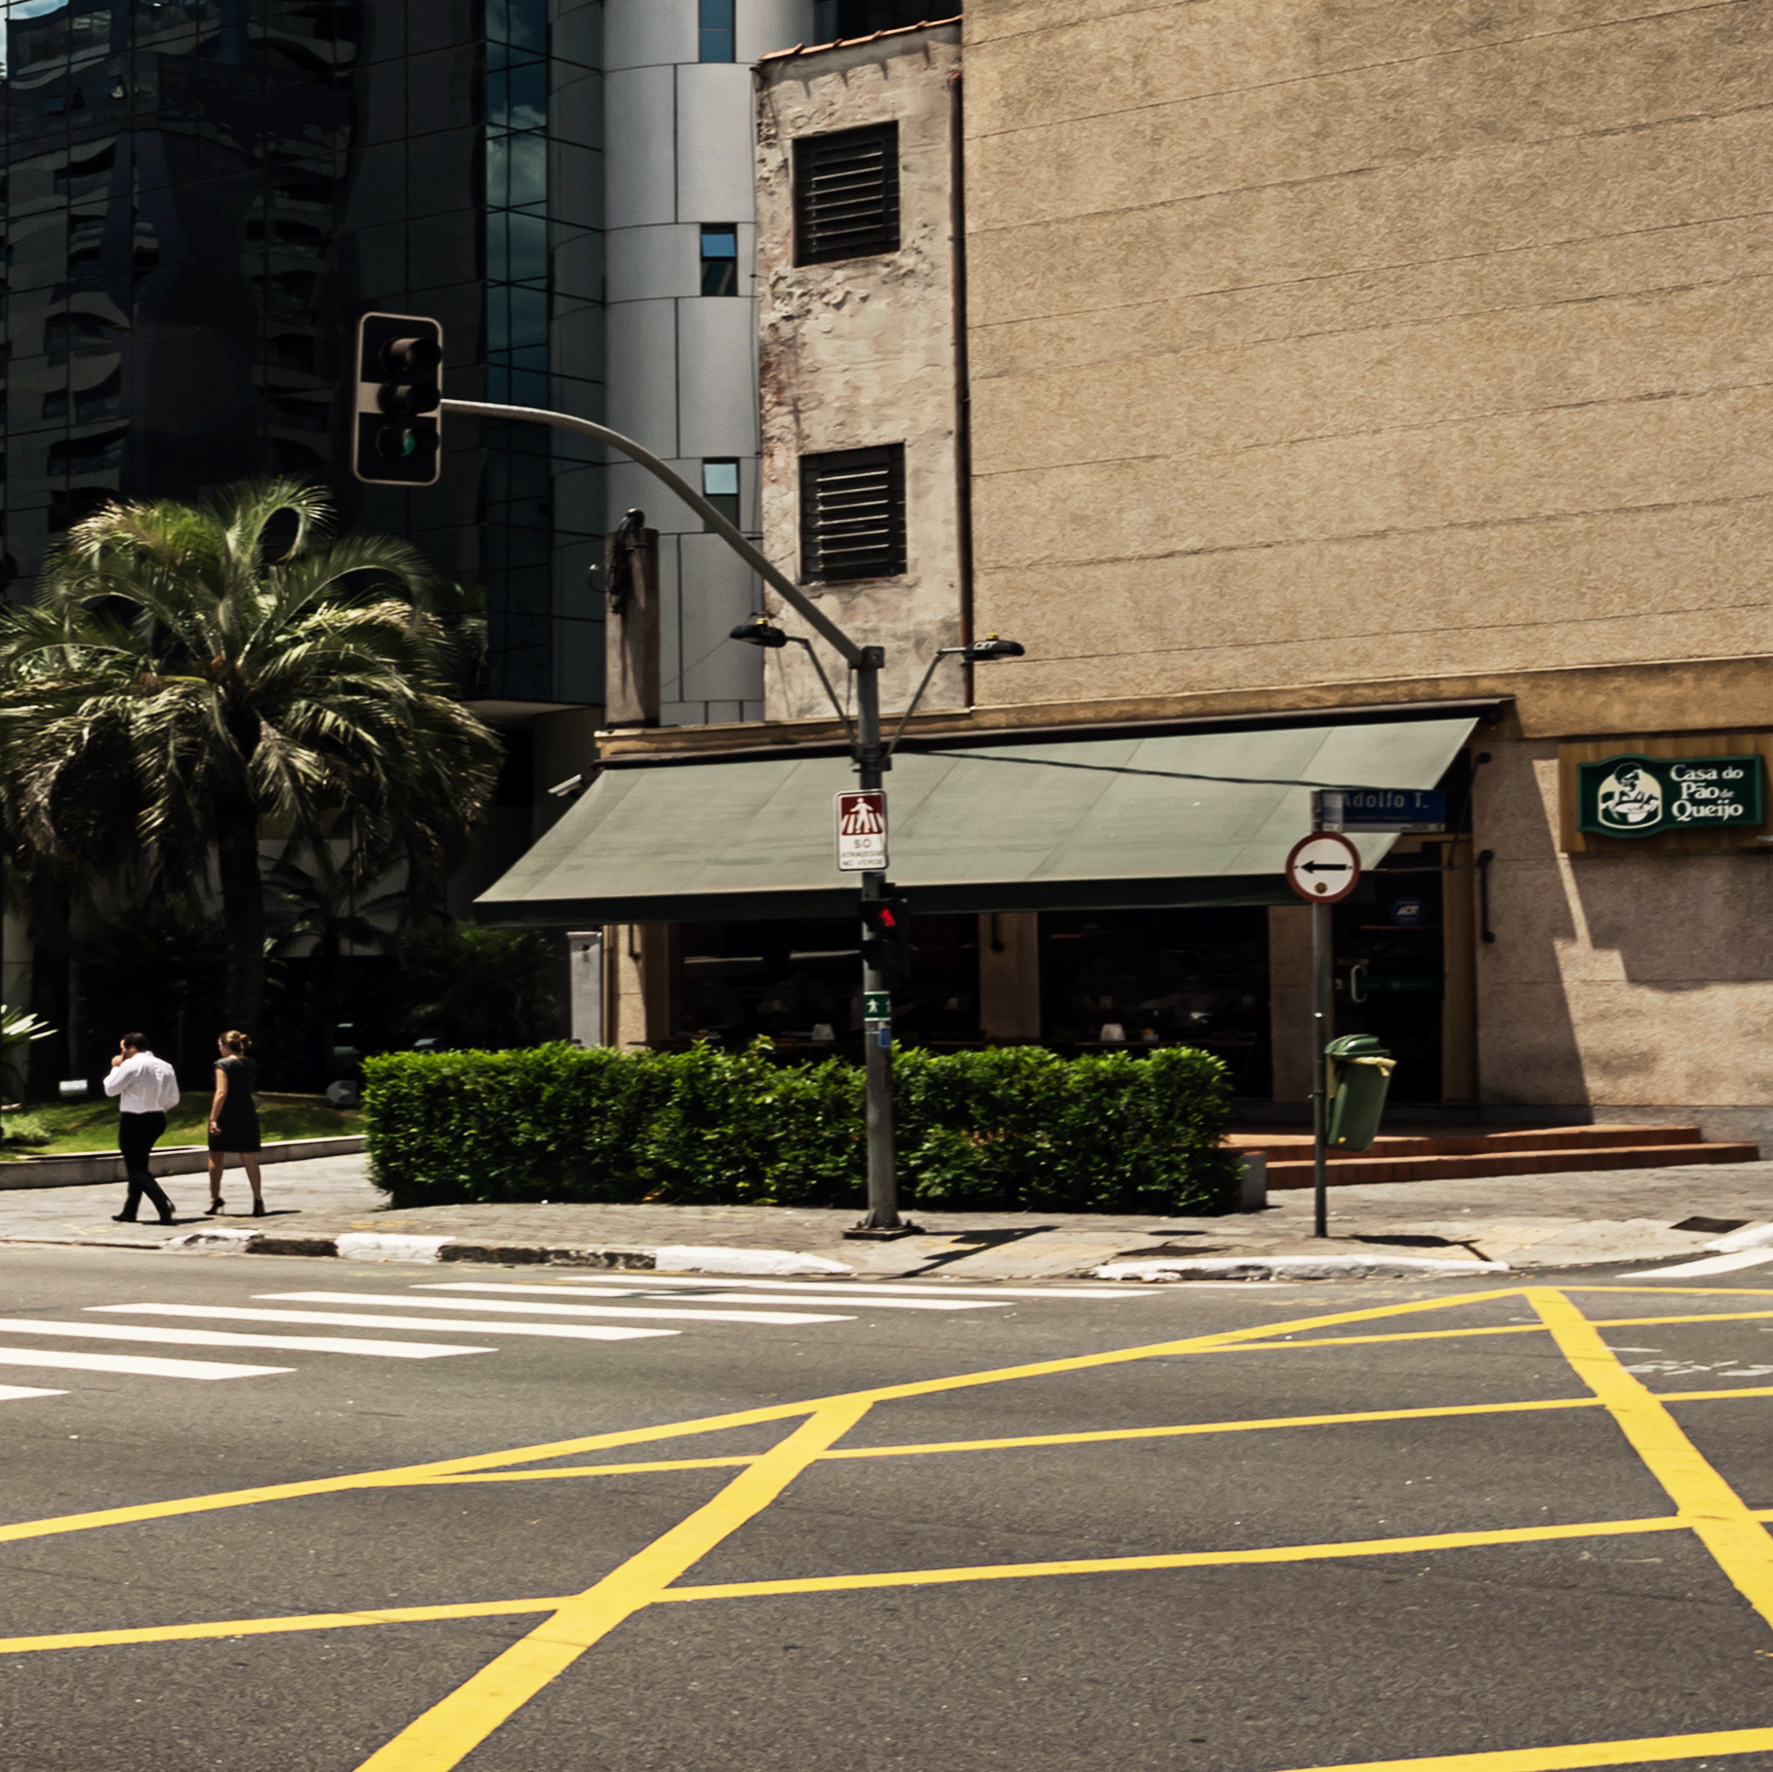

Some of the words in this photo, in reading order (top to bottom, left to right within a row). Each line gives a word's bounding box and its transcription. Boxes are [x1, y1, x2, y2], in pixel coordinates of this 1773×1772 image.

[1670, 764, 1718, 782] Casa
[1722, 765, 1744, 779] do
[1680, 781, 1720, 799] Pão
[1342, 792, 1405, 808] Adolfo
[1671, 800, 1744, 822] Queijo
